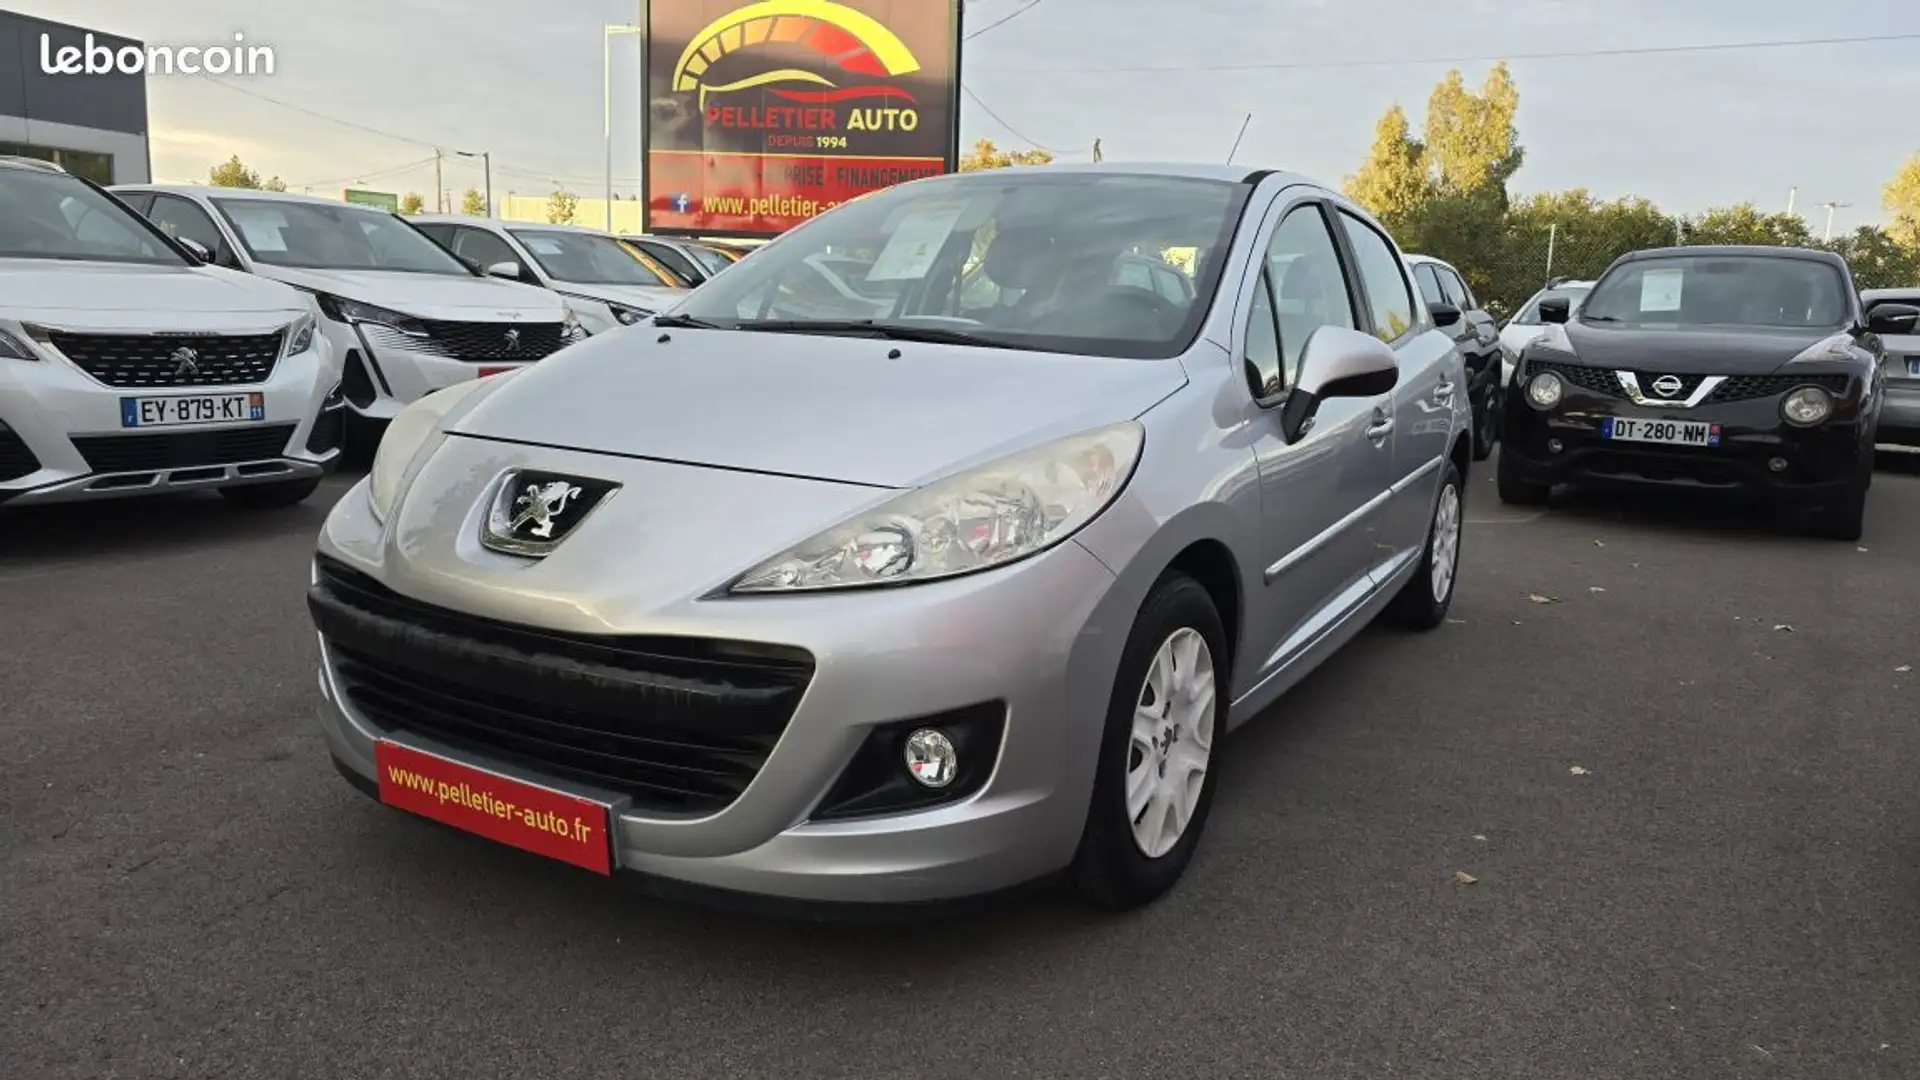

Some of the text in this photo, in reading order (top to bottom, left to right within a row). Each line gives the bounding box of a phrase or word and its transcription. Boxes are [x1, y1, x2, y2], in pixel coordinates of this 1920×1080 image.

[706, 106, 918, 131] PELLETIER AUTO
[768, 135, 848, 148] DEPUIS 1994
[388, 764, 592, 844] www.pelletier-auto.fr
